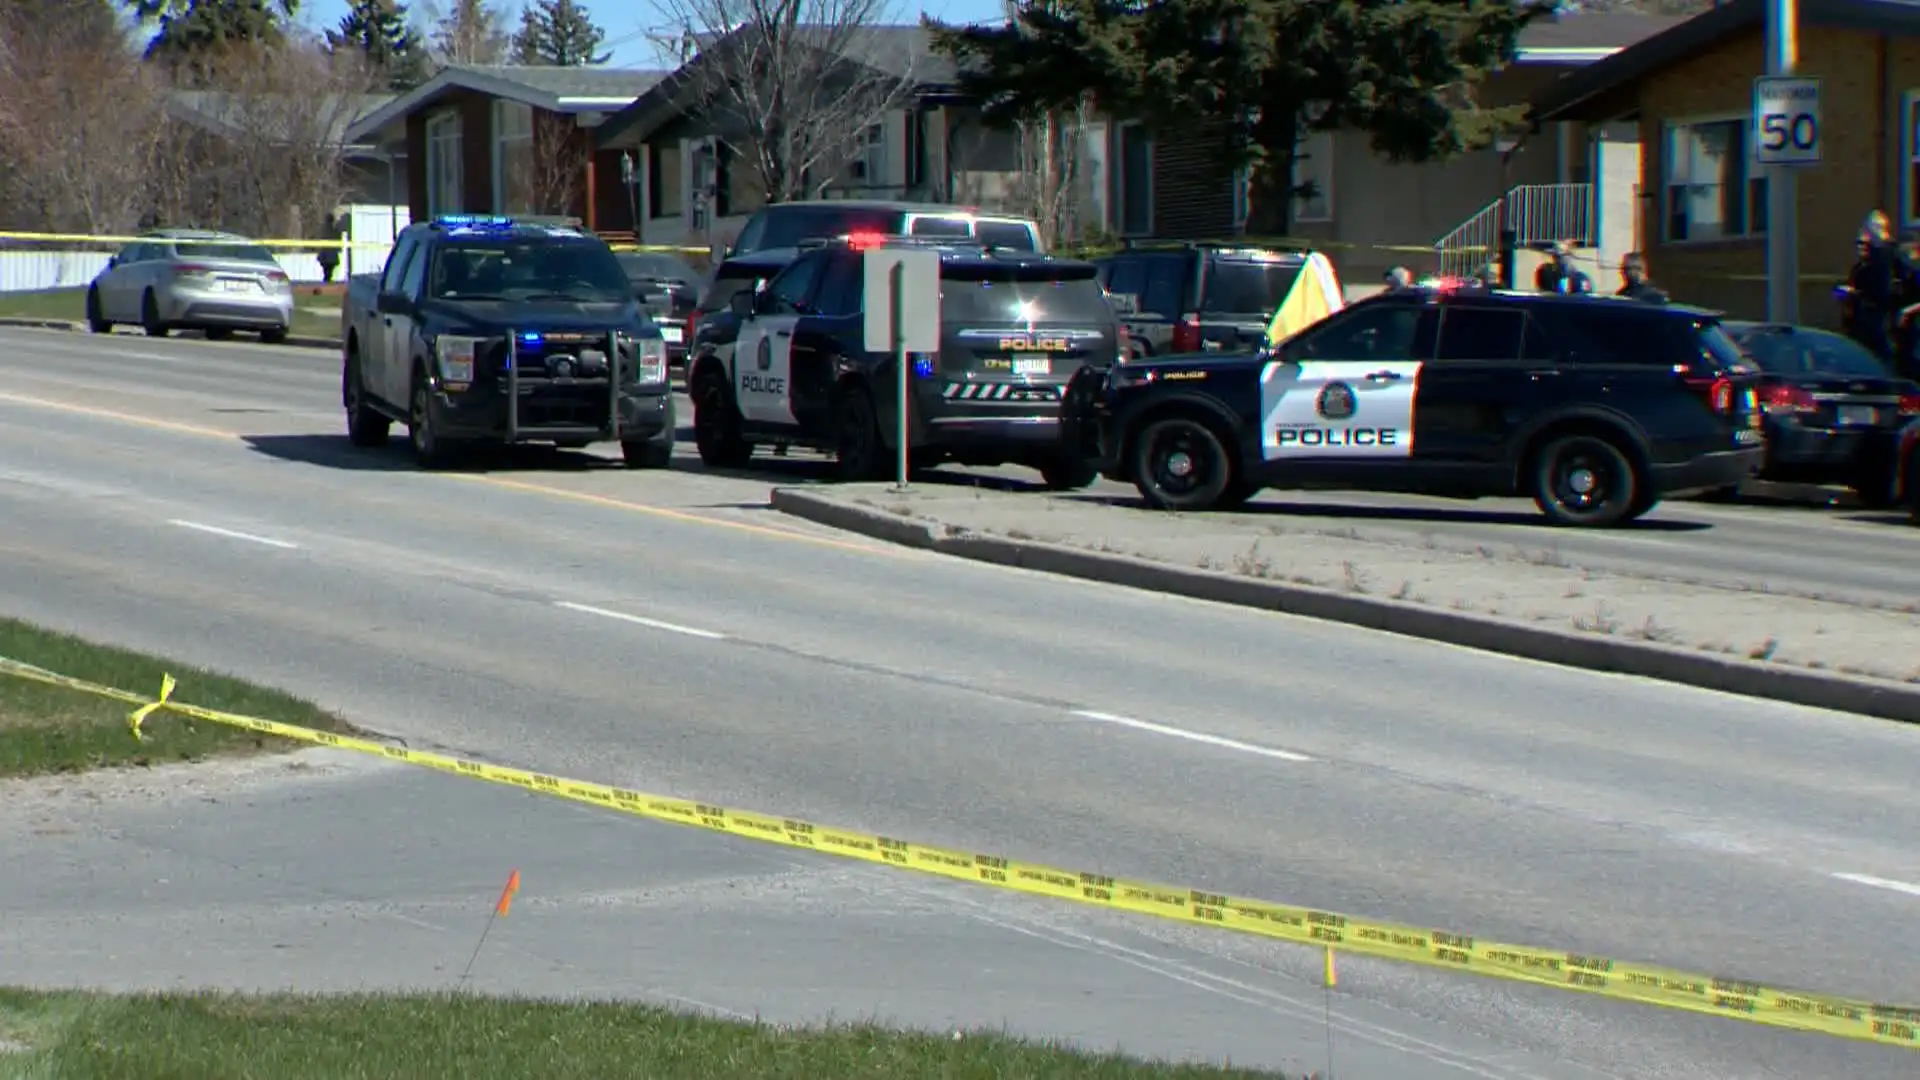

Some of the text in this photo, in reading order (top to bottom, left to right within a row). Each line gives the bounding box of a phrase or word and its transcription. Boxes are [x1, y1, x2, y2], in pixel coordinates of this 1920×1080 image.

[1763, 113, 1816, 151] 50
[999, 338, 1066, 351] POLICE
[742, 375, 785, 394] POLICE
[1276, 428, 1396, 445] POLICE
